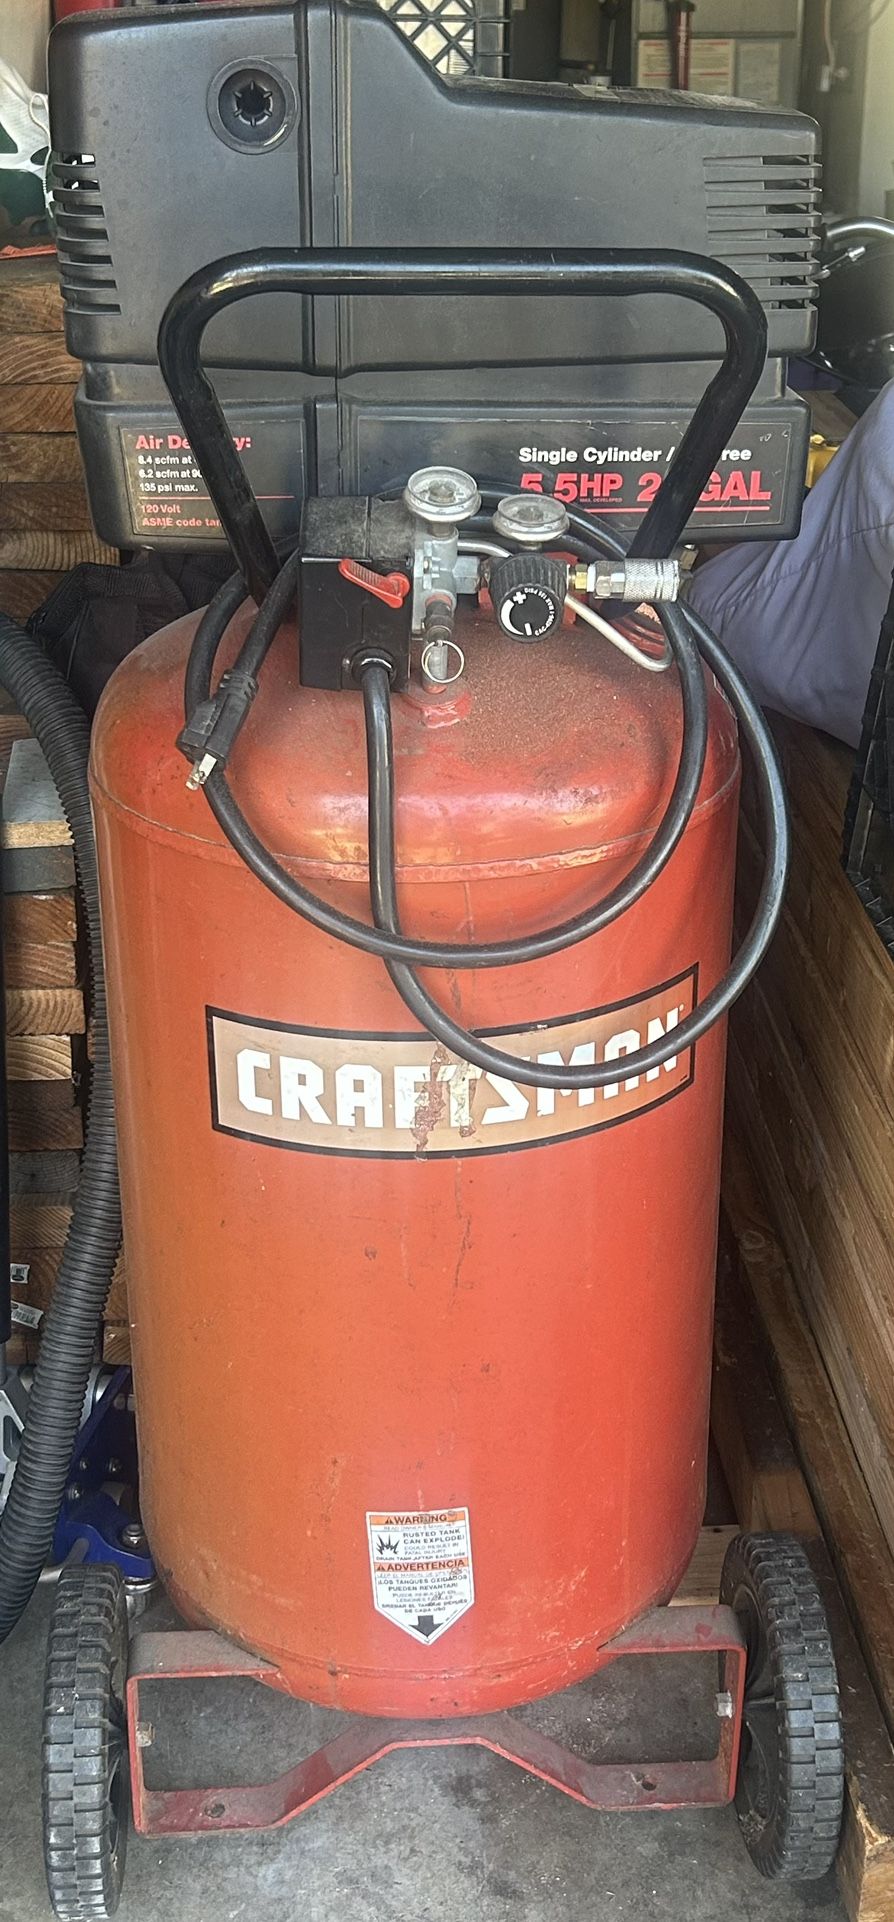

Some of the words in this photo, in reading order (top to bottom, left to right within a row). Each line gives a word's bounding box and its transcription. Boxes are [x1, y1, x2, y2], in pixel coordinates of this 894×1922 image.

[136, 435, 163, 449] Air
[138, 455, 152, 464] 8.4
[155, 456, 179, 464] scfm
[182, 456, 192, 464] at
[519, 447, 577, 465] Single
[583, 447, 661, 465] Cylinder
[721, 449, 752, 461] ree
[155, 469, 179, 478] scfm
[181, 469, 190, 478] at
[140, 483, 156, 492] 135
[158, 483, 172, 493] psi
[175, 484, 198, 492] max.
[141, 505, 158, 513] 120
[160, 505, 181, 513] Volt
[142, 518, 173, 526] ASME
[175, 518, 202, 526] code
[393, 1513, 447, 1525] WARNING
[387, 1559, 465, 1572] ADVERTENCIA
